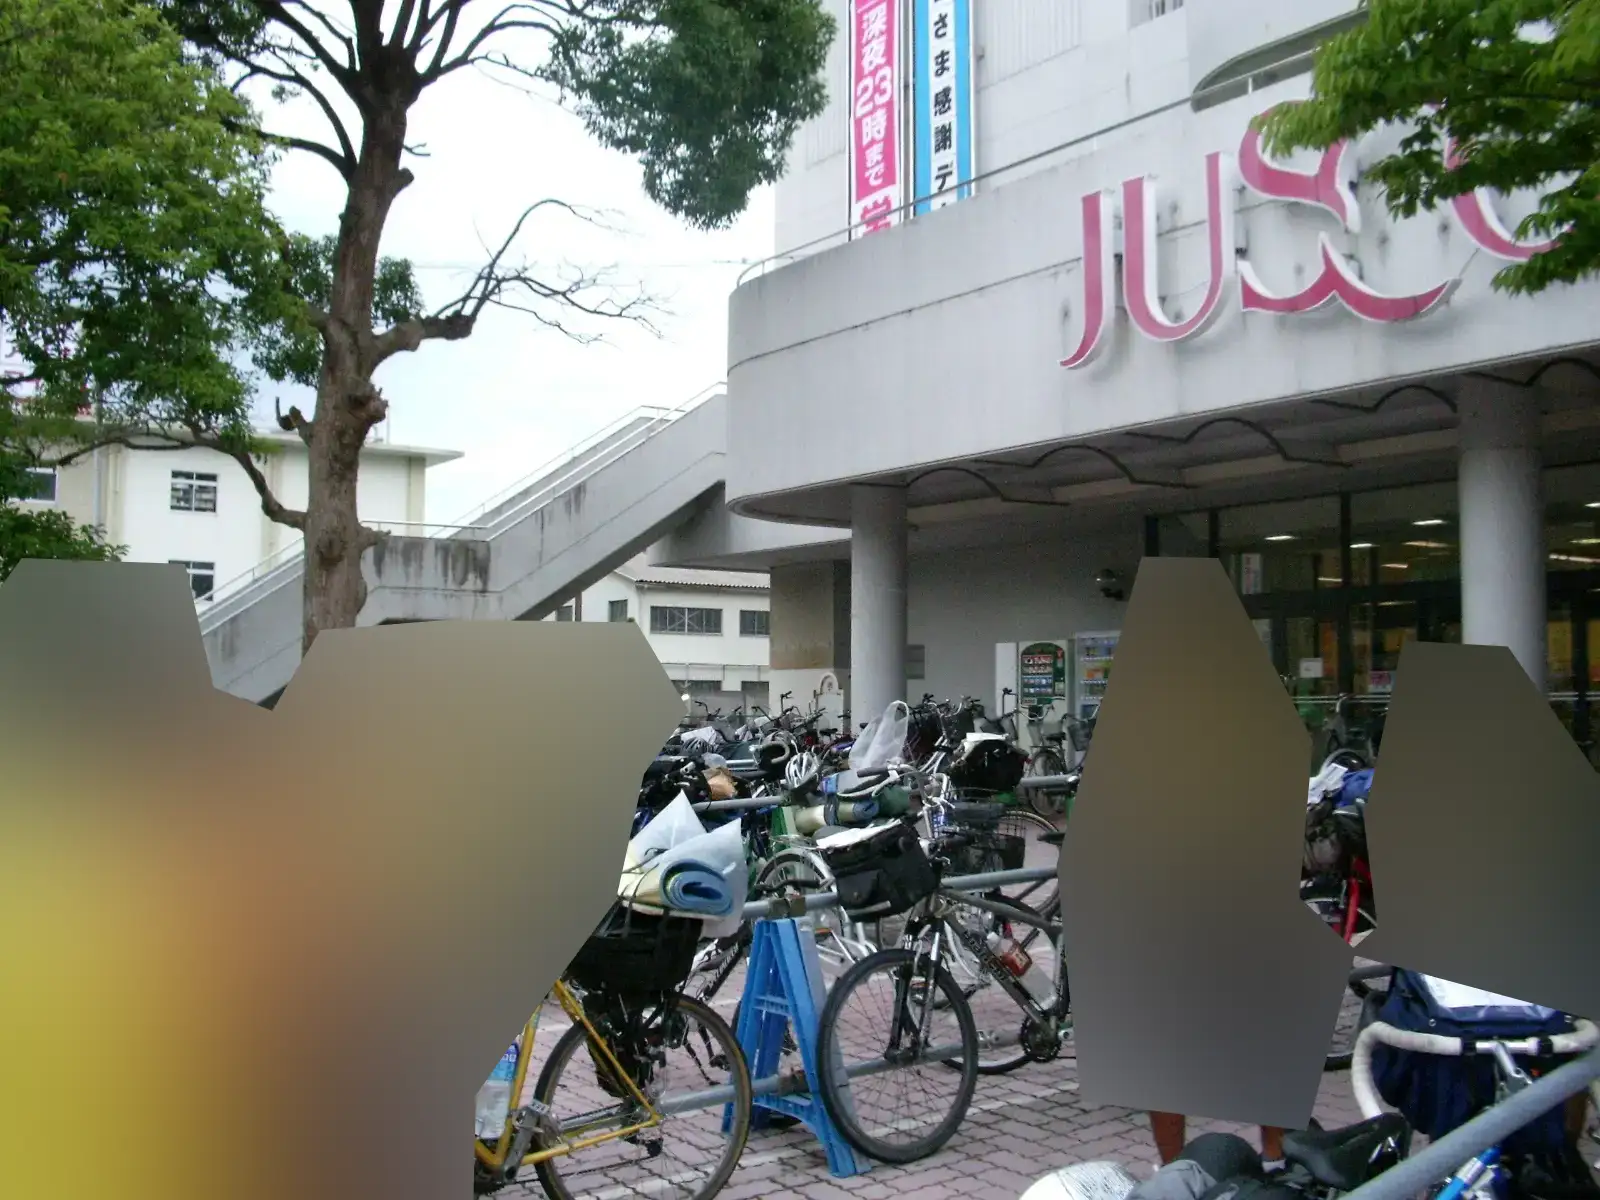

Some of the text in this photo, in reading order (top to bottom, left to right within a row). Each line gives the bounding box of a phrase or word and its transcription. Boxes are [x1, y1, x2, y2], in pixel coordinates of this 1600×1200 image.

[934, 0, 953, 207] さま感謝デ
